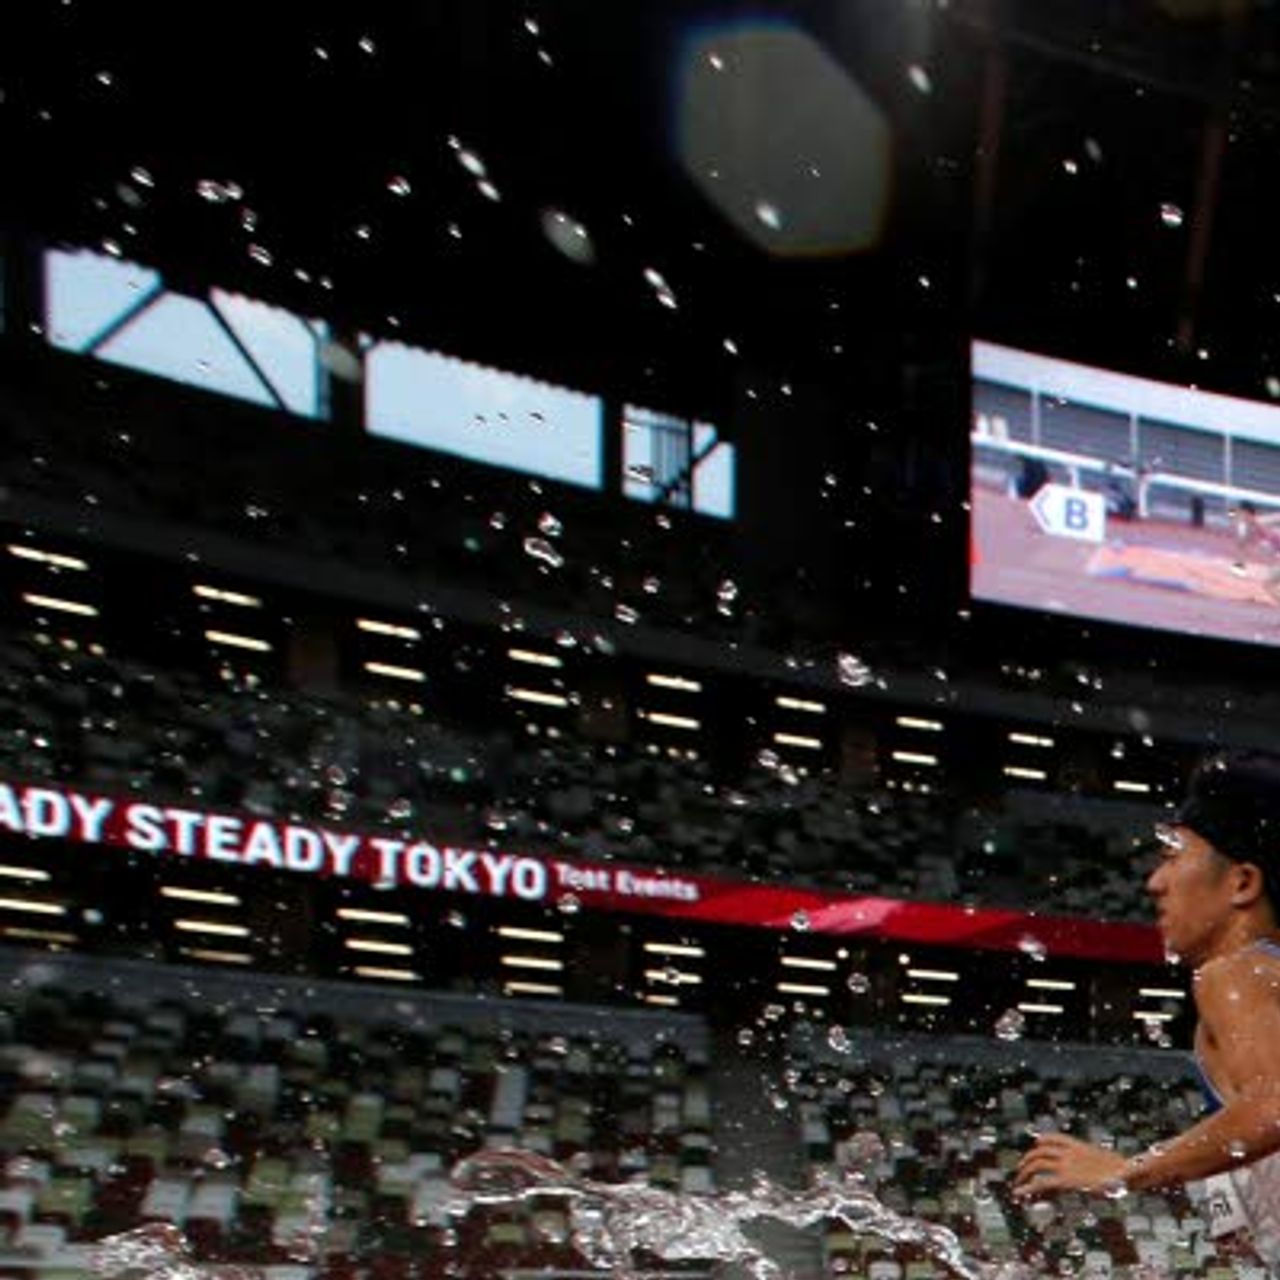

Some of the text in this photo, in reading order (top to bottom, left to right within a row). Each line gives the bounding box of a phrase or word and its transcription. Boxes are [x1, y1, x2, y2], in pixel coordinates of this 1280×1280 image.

[1065, 498, 1090, 532] B
[124, 803, 359, 876] STEADY
[369, 836, 547, 900] TOKYO
[555, 862, 609, 890] Test
[615, 869, 700, 901] Events
